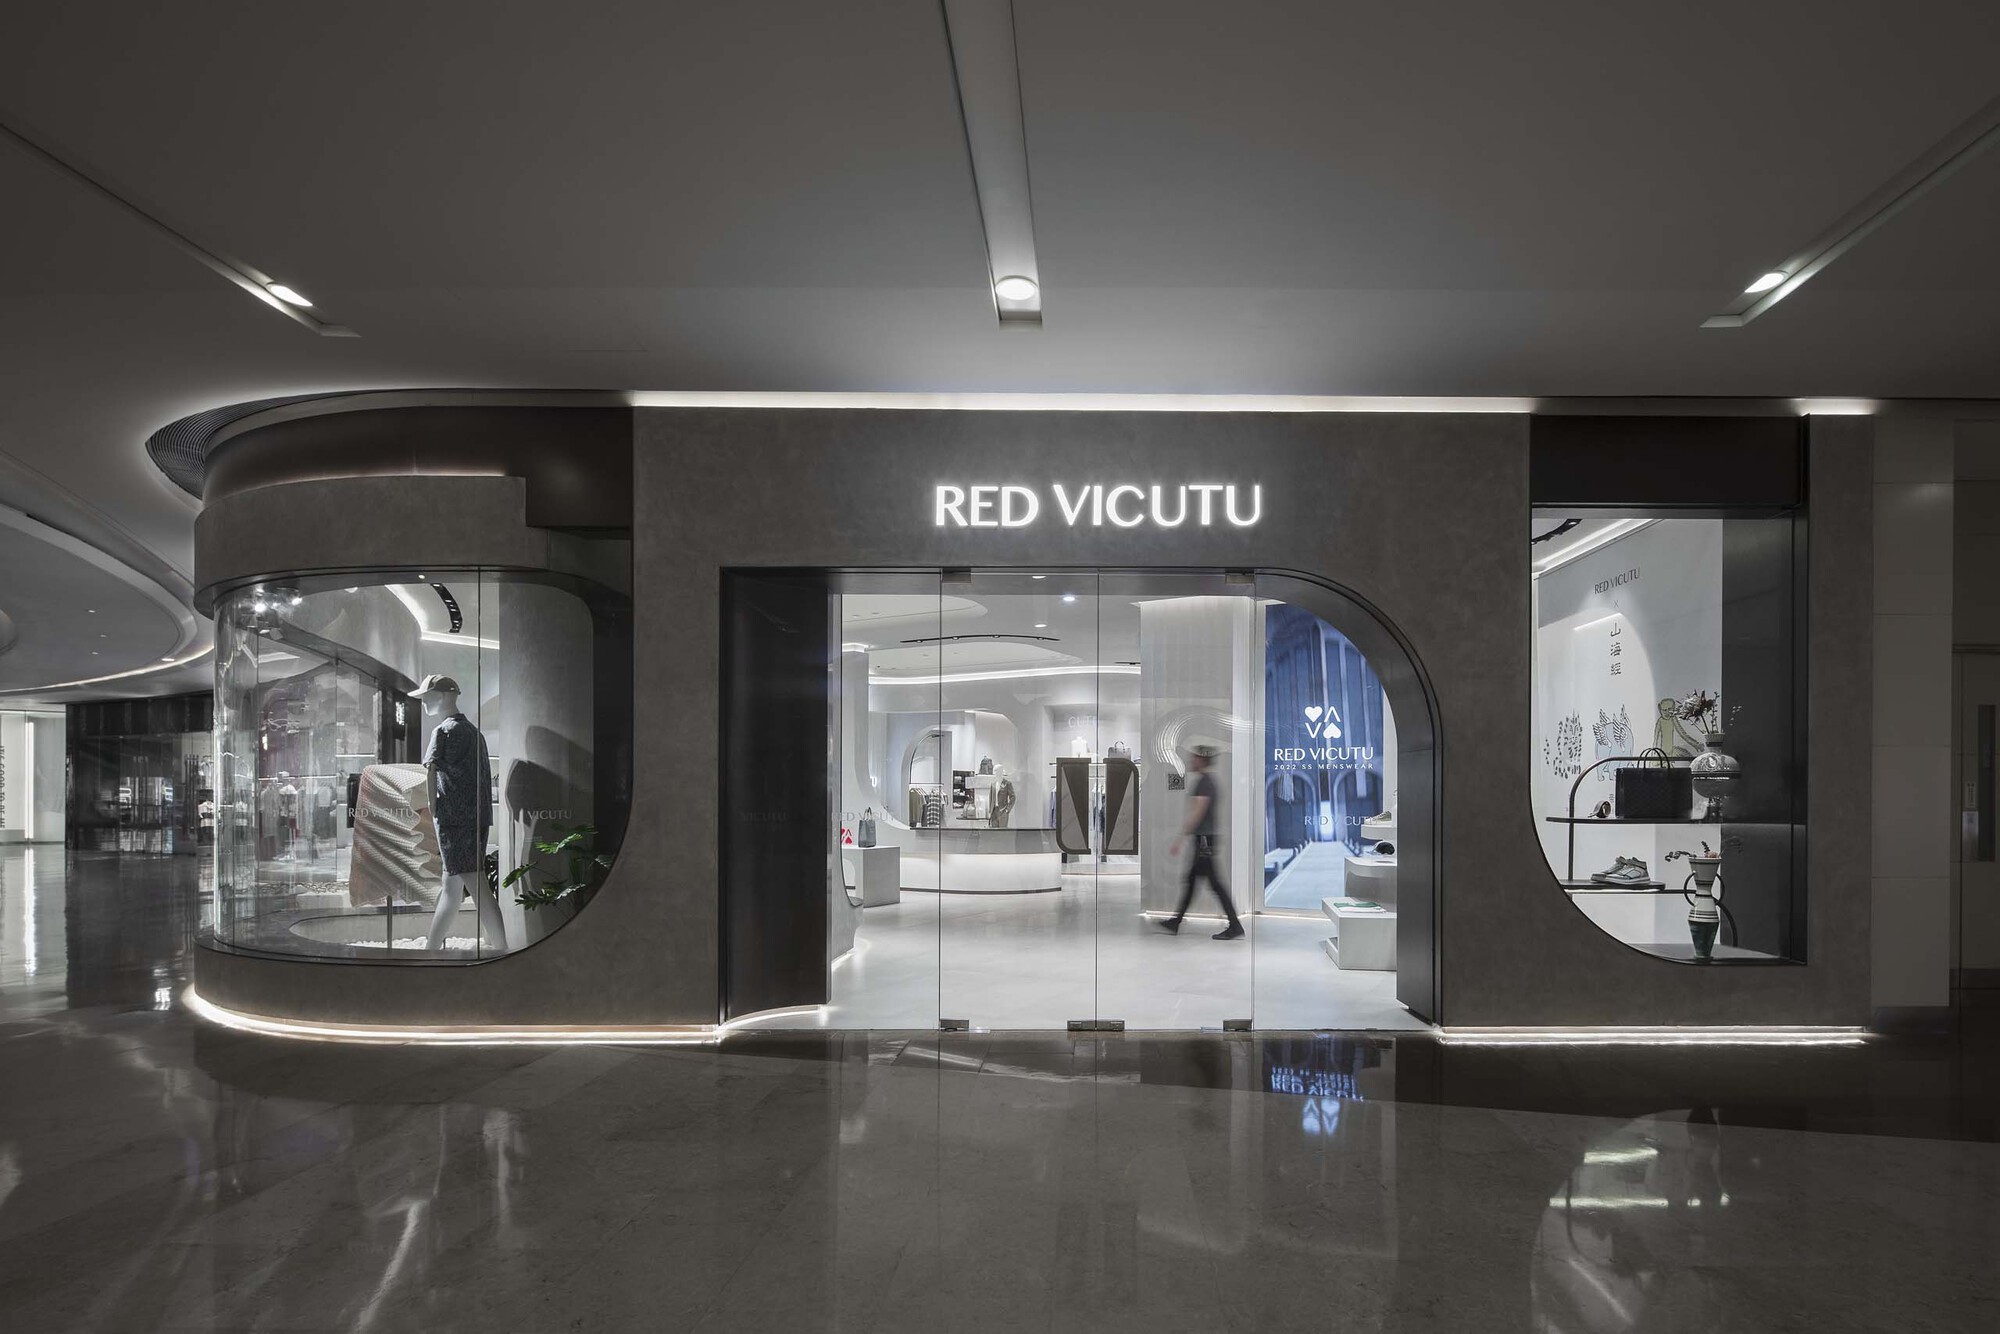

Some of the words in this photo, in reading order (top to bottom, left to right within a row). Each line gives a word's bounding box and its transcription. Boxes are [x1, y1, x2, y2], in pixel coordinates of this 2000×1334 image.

[935, 485, 1039, 527] RED
[1052, 484, 1261, 527] VICUTU
[1594, 580, 1609, 594] RED
[1610, 567, 1640, 588] VICUTU
[1274, 748, 1306, 761] RED
[1309, 746, 1374, 760] VICUTU
[527, 809, 573, 821] VICUTU
